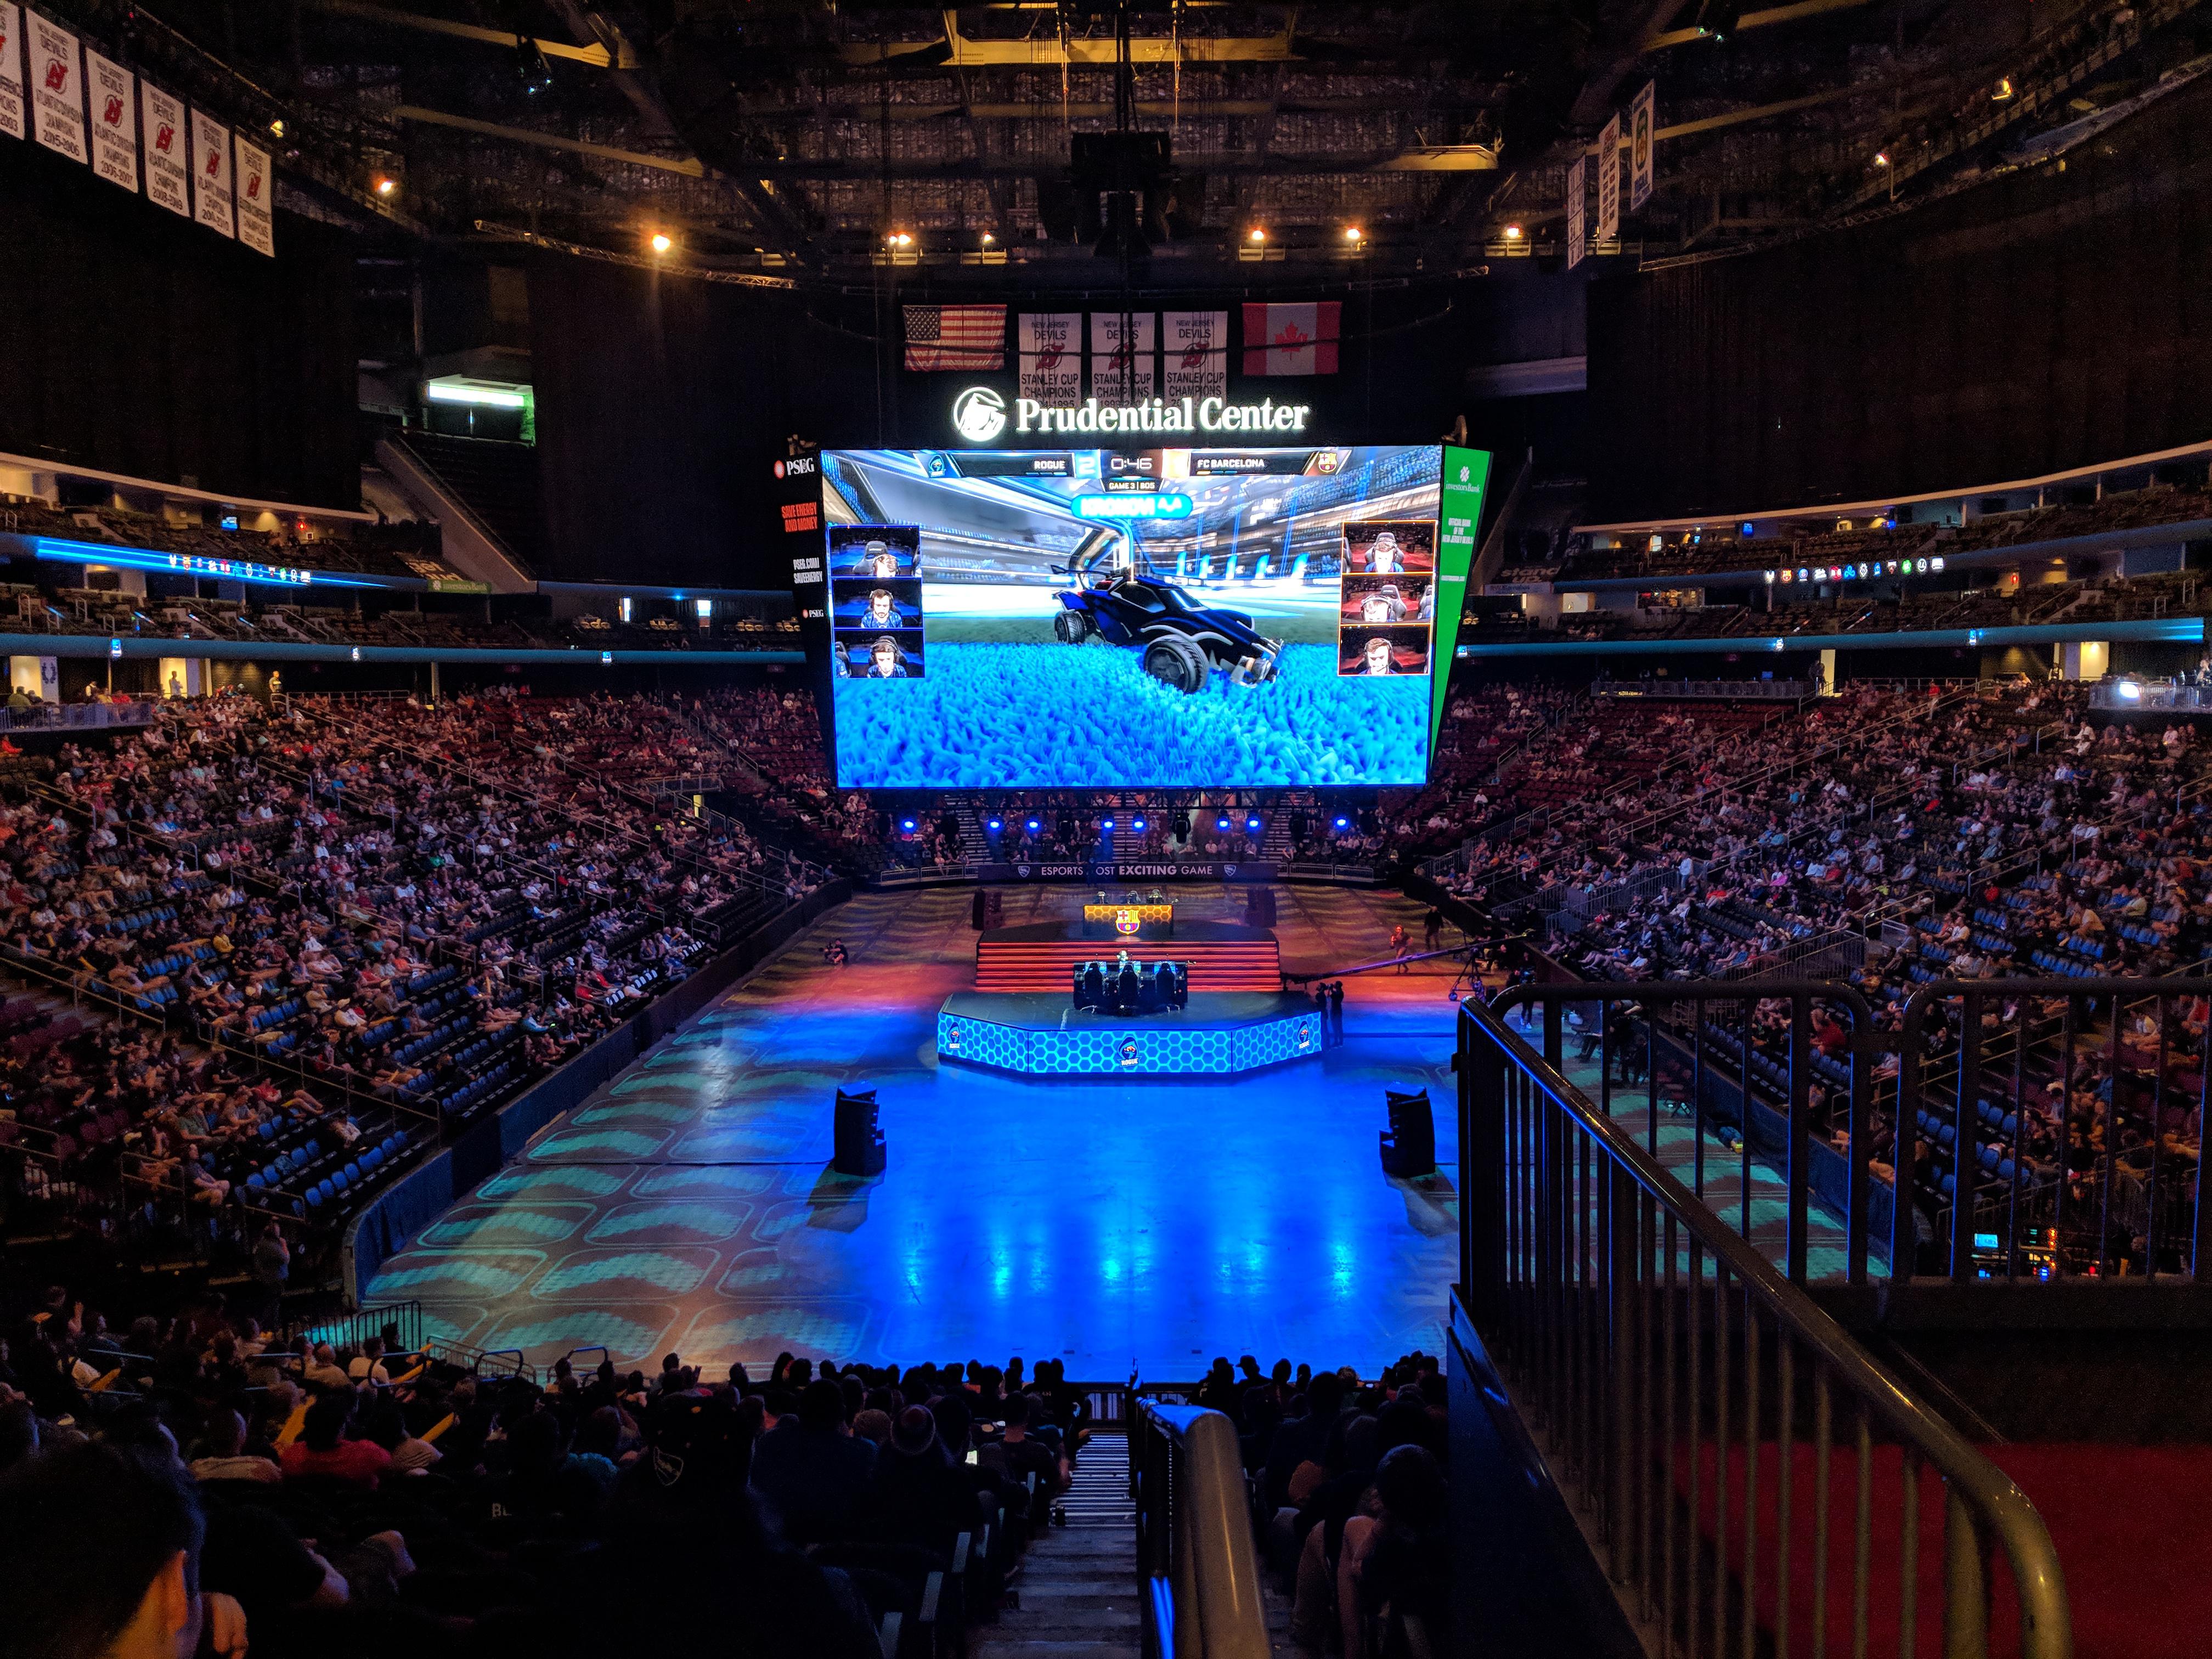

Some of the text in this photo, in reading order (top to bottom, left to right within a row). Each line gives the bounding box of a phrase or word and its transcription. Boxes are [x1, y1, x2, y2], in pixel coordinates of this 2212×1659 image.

[1035, 330, 1066, 340] DEVILS
[1179, 329, 1211, 338] DEVILS
[1022, 373, 1079, 385] STANLEY CUP
[1134, 373, 1152, 385] CUP
[1167, 371, 1224, 383] STANLEY CUP
[1024, 386, 1076, 398] CHAMPIONS
[1096, 386, 1150, 398] CHAMPINS
[1169, 385, 1222, 397] CHAMPIONS
[1015, 397, 1310, 431] Prudential Center
[786, 458, 815, 476] PSEG
[1034, 460, 1066, 470] ROGUE
[1078, 457, 1096, 475] 2
[1110, 457, 1153, 470] 0:46
[1197, 459, 1265, 468] FC BARCELONA
[1109, 482, 1130, 490] GAME
[1130, 482, 1136, 490] 3
[781, 501, 817, 519] SAVE ENERGY
[785, 516, 818, 533] AND MONEY
[794, 571, 823, 584] SAVEENERGY
[809, 609, 824, 618] PSEG
[1041, 865, 1213, 876] ESPORTS OST EXCITING GAME
[1121, 1058, 1139, 1066] ROGUE
